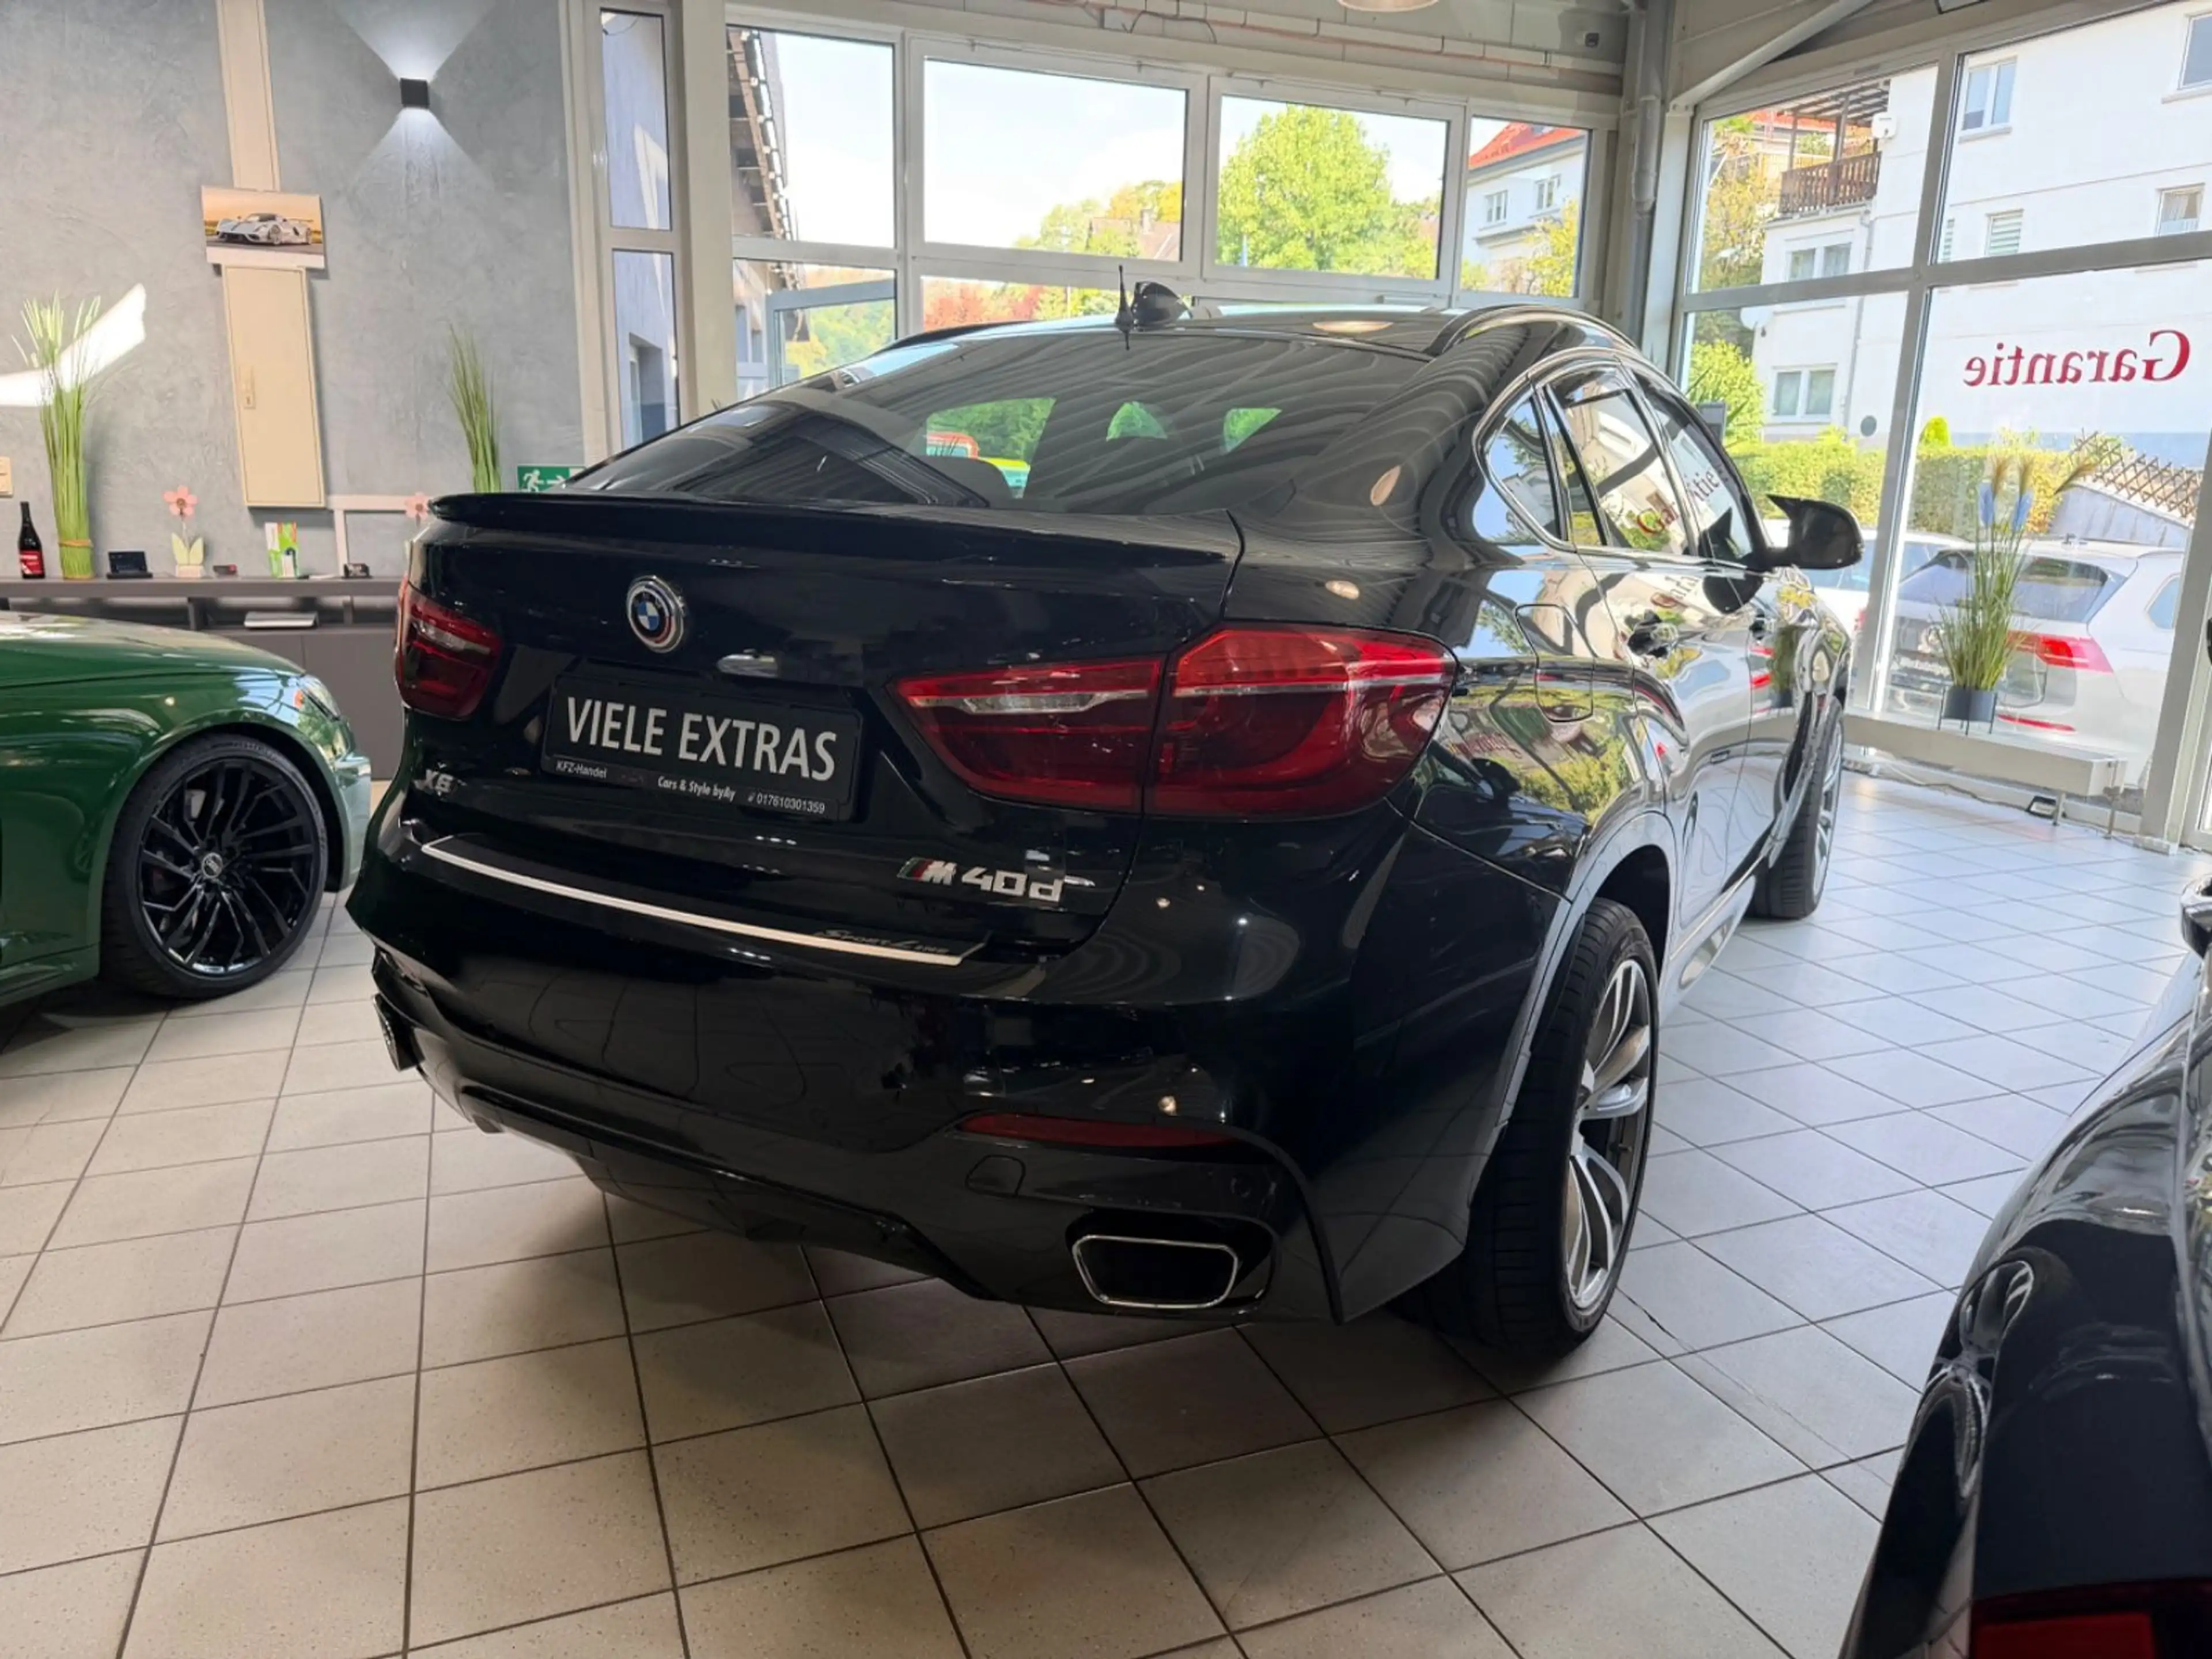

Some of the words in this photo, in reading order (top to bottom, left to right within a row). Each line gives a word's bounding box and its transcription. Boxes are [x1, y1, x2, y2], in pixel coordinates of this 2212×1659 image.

[567, 696, 667, 756] VIELE
[678, 713, 837, 782] EXTRAS
[414, 768, 456, 794] X6
[555, 760, 608, 779] KFZ-Handel
[657, 775, 677, 790] Cars
[679, 779, 687, 791] &
[689, 781, 711, 797] Style
